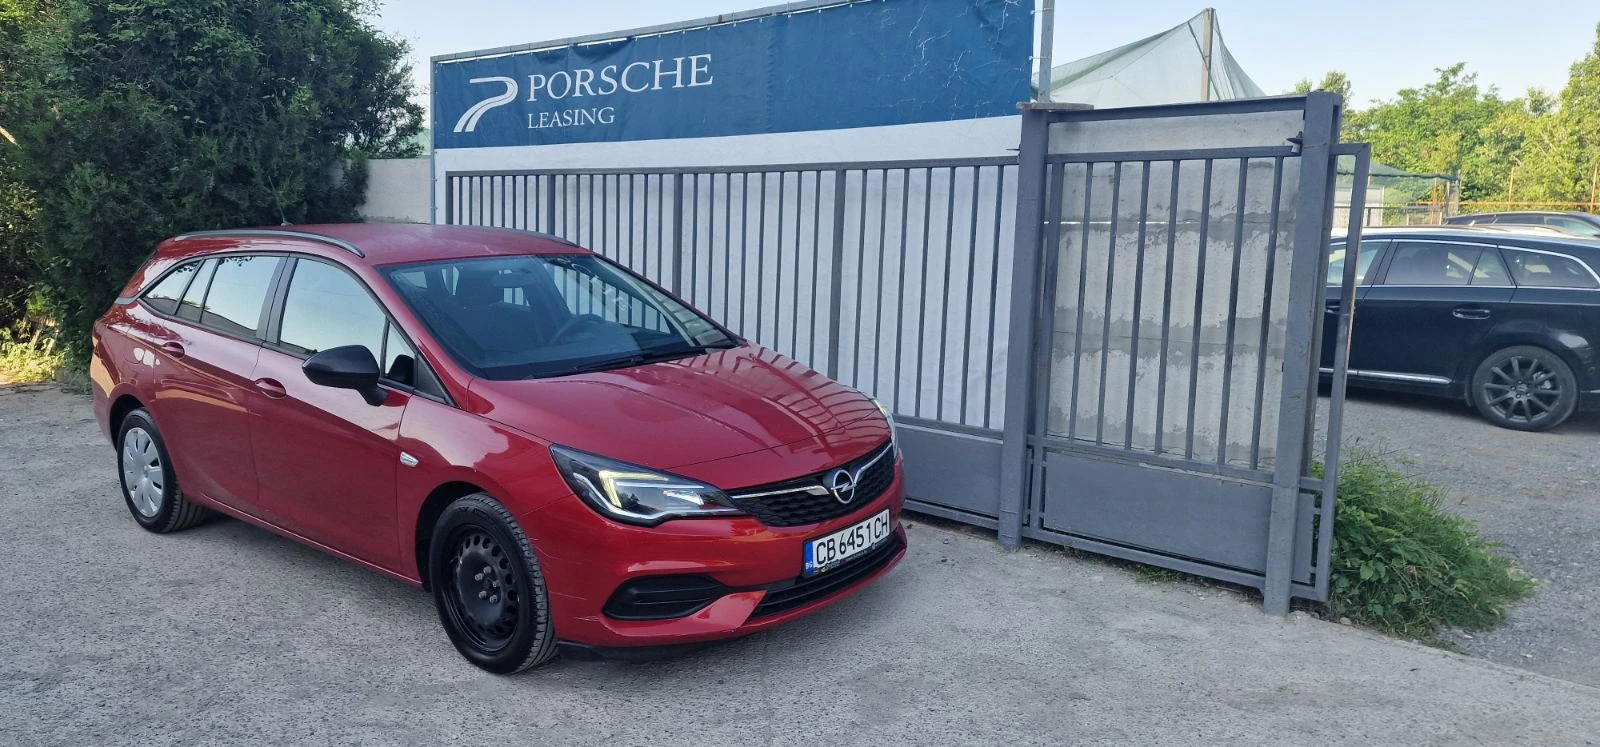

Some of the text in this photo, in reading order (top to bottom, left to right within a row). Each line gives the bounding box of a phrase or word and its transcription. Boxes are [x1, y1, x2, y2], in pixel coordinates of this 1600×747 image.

[527, 54, 713, 102] PORSCHE
[528, 107, 615, 129] LEASING
[816, 538, 836, 565] CB
[839, 522, 871, 555] 6451
[874, 513, 888, 538] CH
